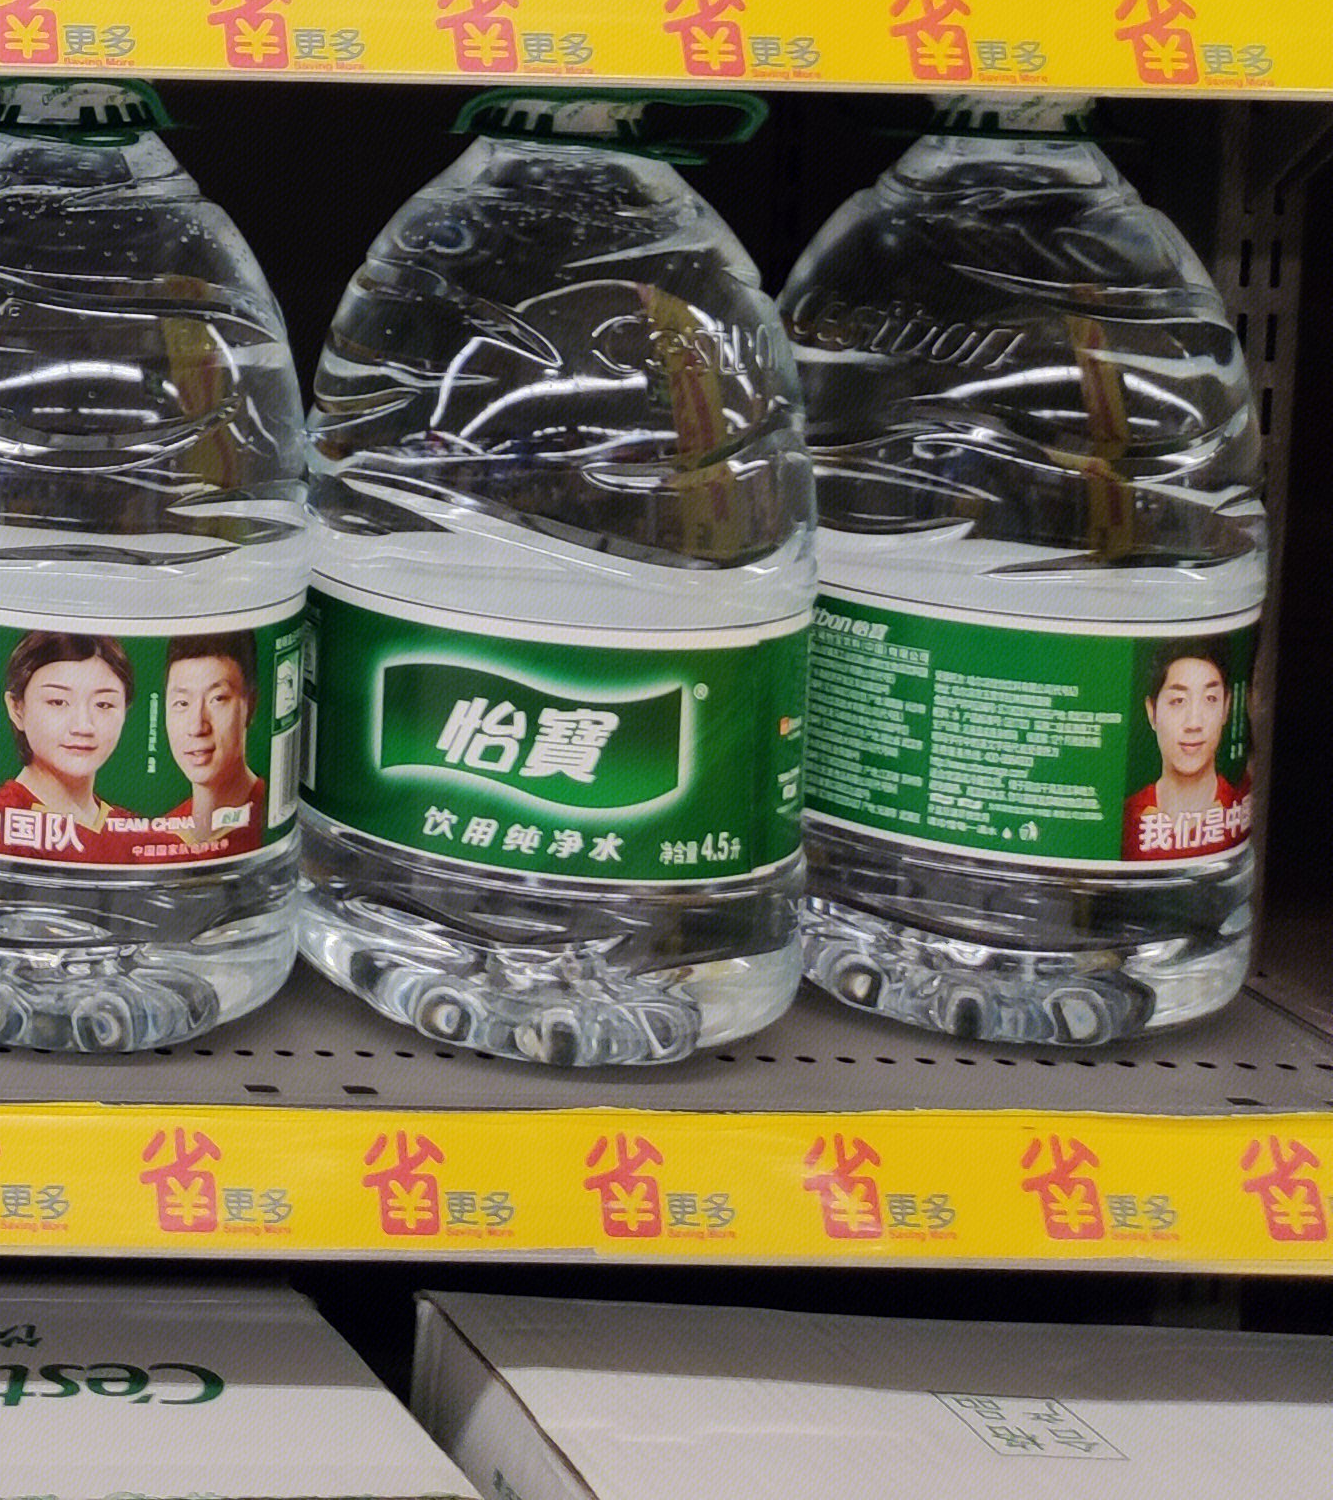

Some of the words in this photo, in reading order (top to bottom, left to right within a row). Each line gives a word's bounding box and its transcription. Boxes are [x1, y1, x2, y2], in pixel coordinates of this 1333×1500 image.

[64, 24, 135, 56] 更多
[522, 32, 593, 65] 更多
[747, 36, 821, 71] 更多
[1200, 44, 1275, 78] 更多
[105, 817, 150, 832] TEAM
[151, 816, 196, 831] CHINA
[422, 804, 625, 863] 饮用纯净水
[141, 1129, 220, 1233] 省
[222, 1187, 292, 1224] 更多
[586, 1136, 663, 1237] 省
[666, 1192, 736, 1228] 更多
[1023, 1138, 1104, 1240] 省
[1106, 1195, 1177, 1230] 更多
